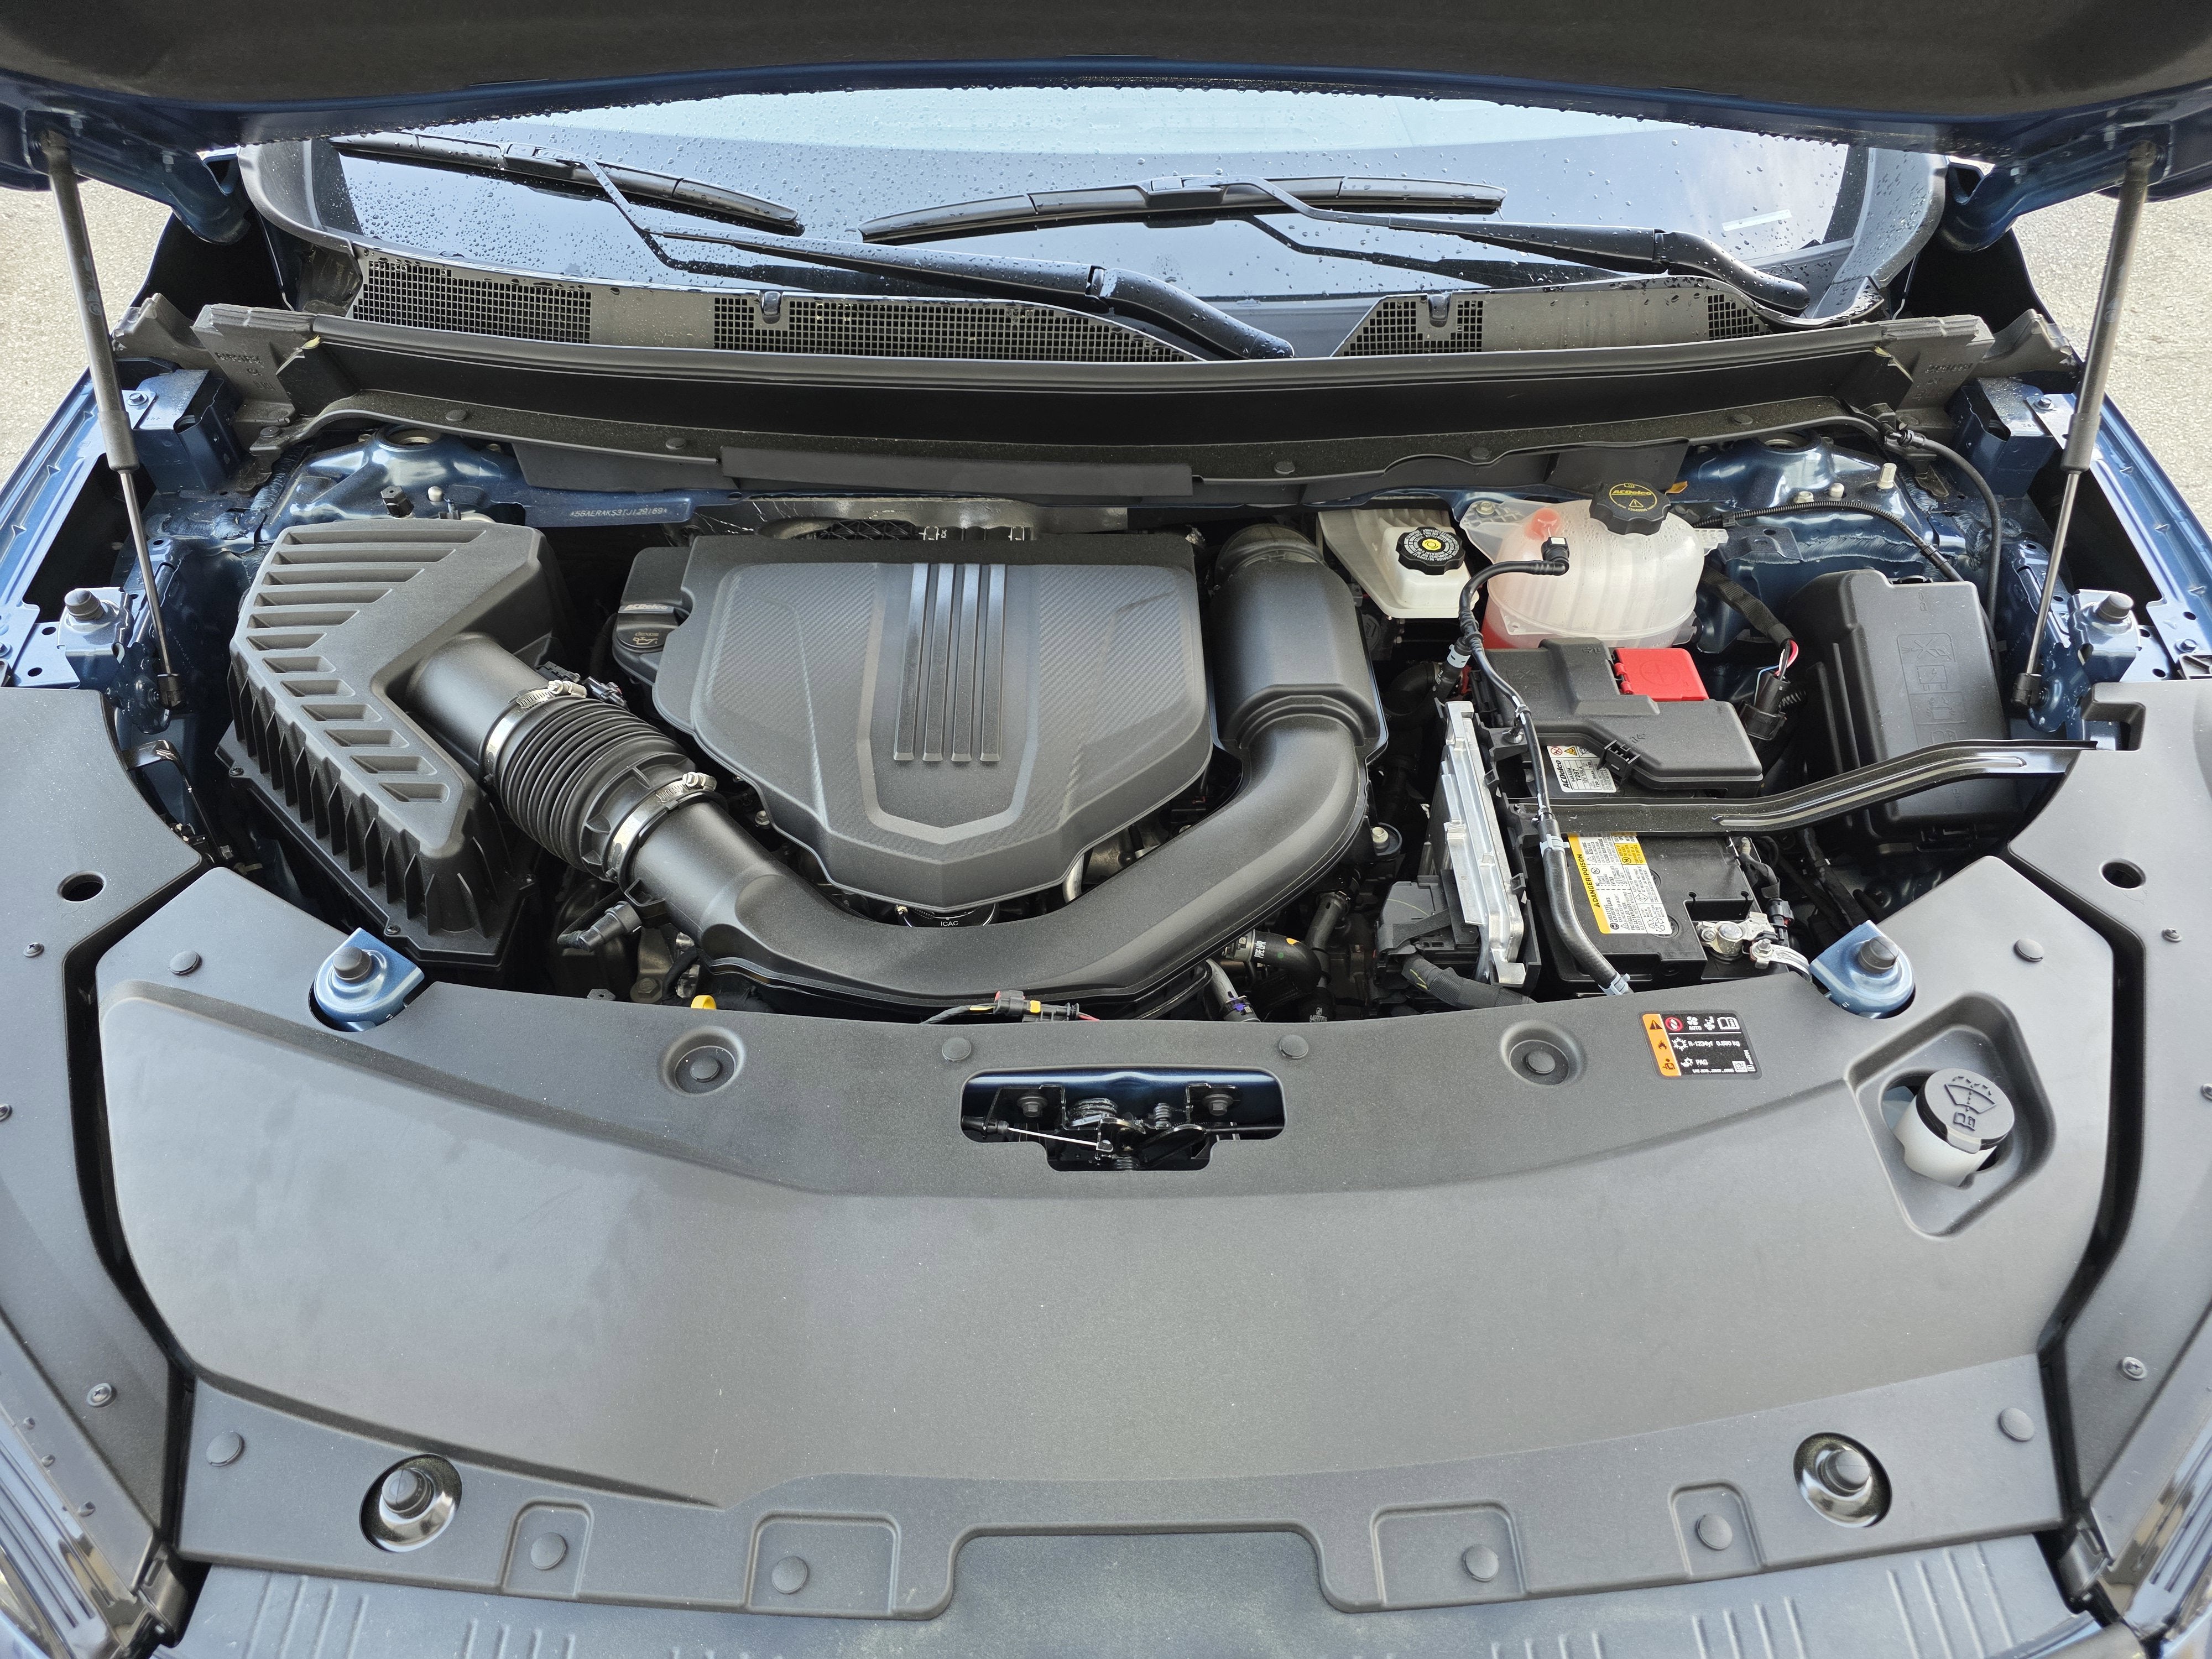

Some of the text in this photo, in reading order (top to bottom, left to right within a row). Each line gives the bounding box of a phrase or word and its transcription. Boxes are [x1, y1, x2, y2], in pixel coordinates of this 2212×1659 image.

[1553, 760, 1570, 788] ACDelco
[1572, 769, 1582, 781] 7287
[1577, 854, 1599, 901] DANGER/POISON
